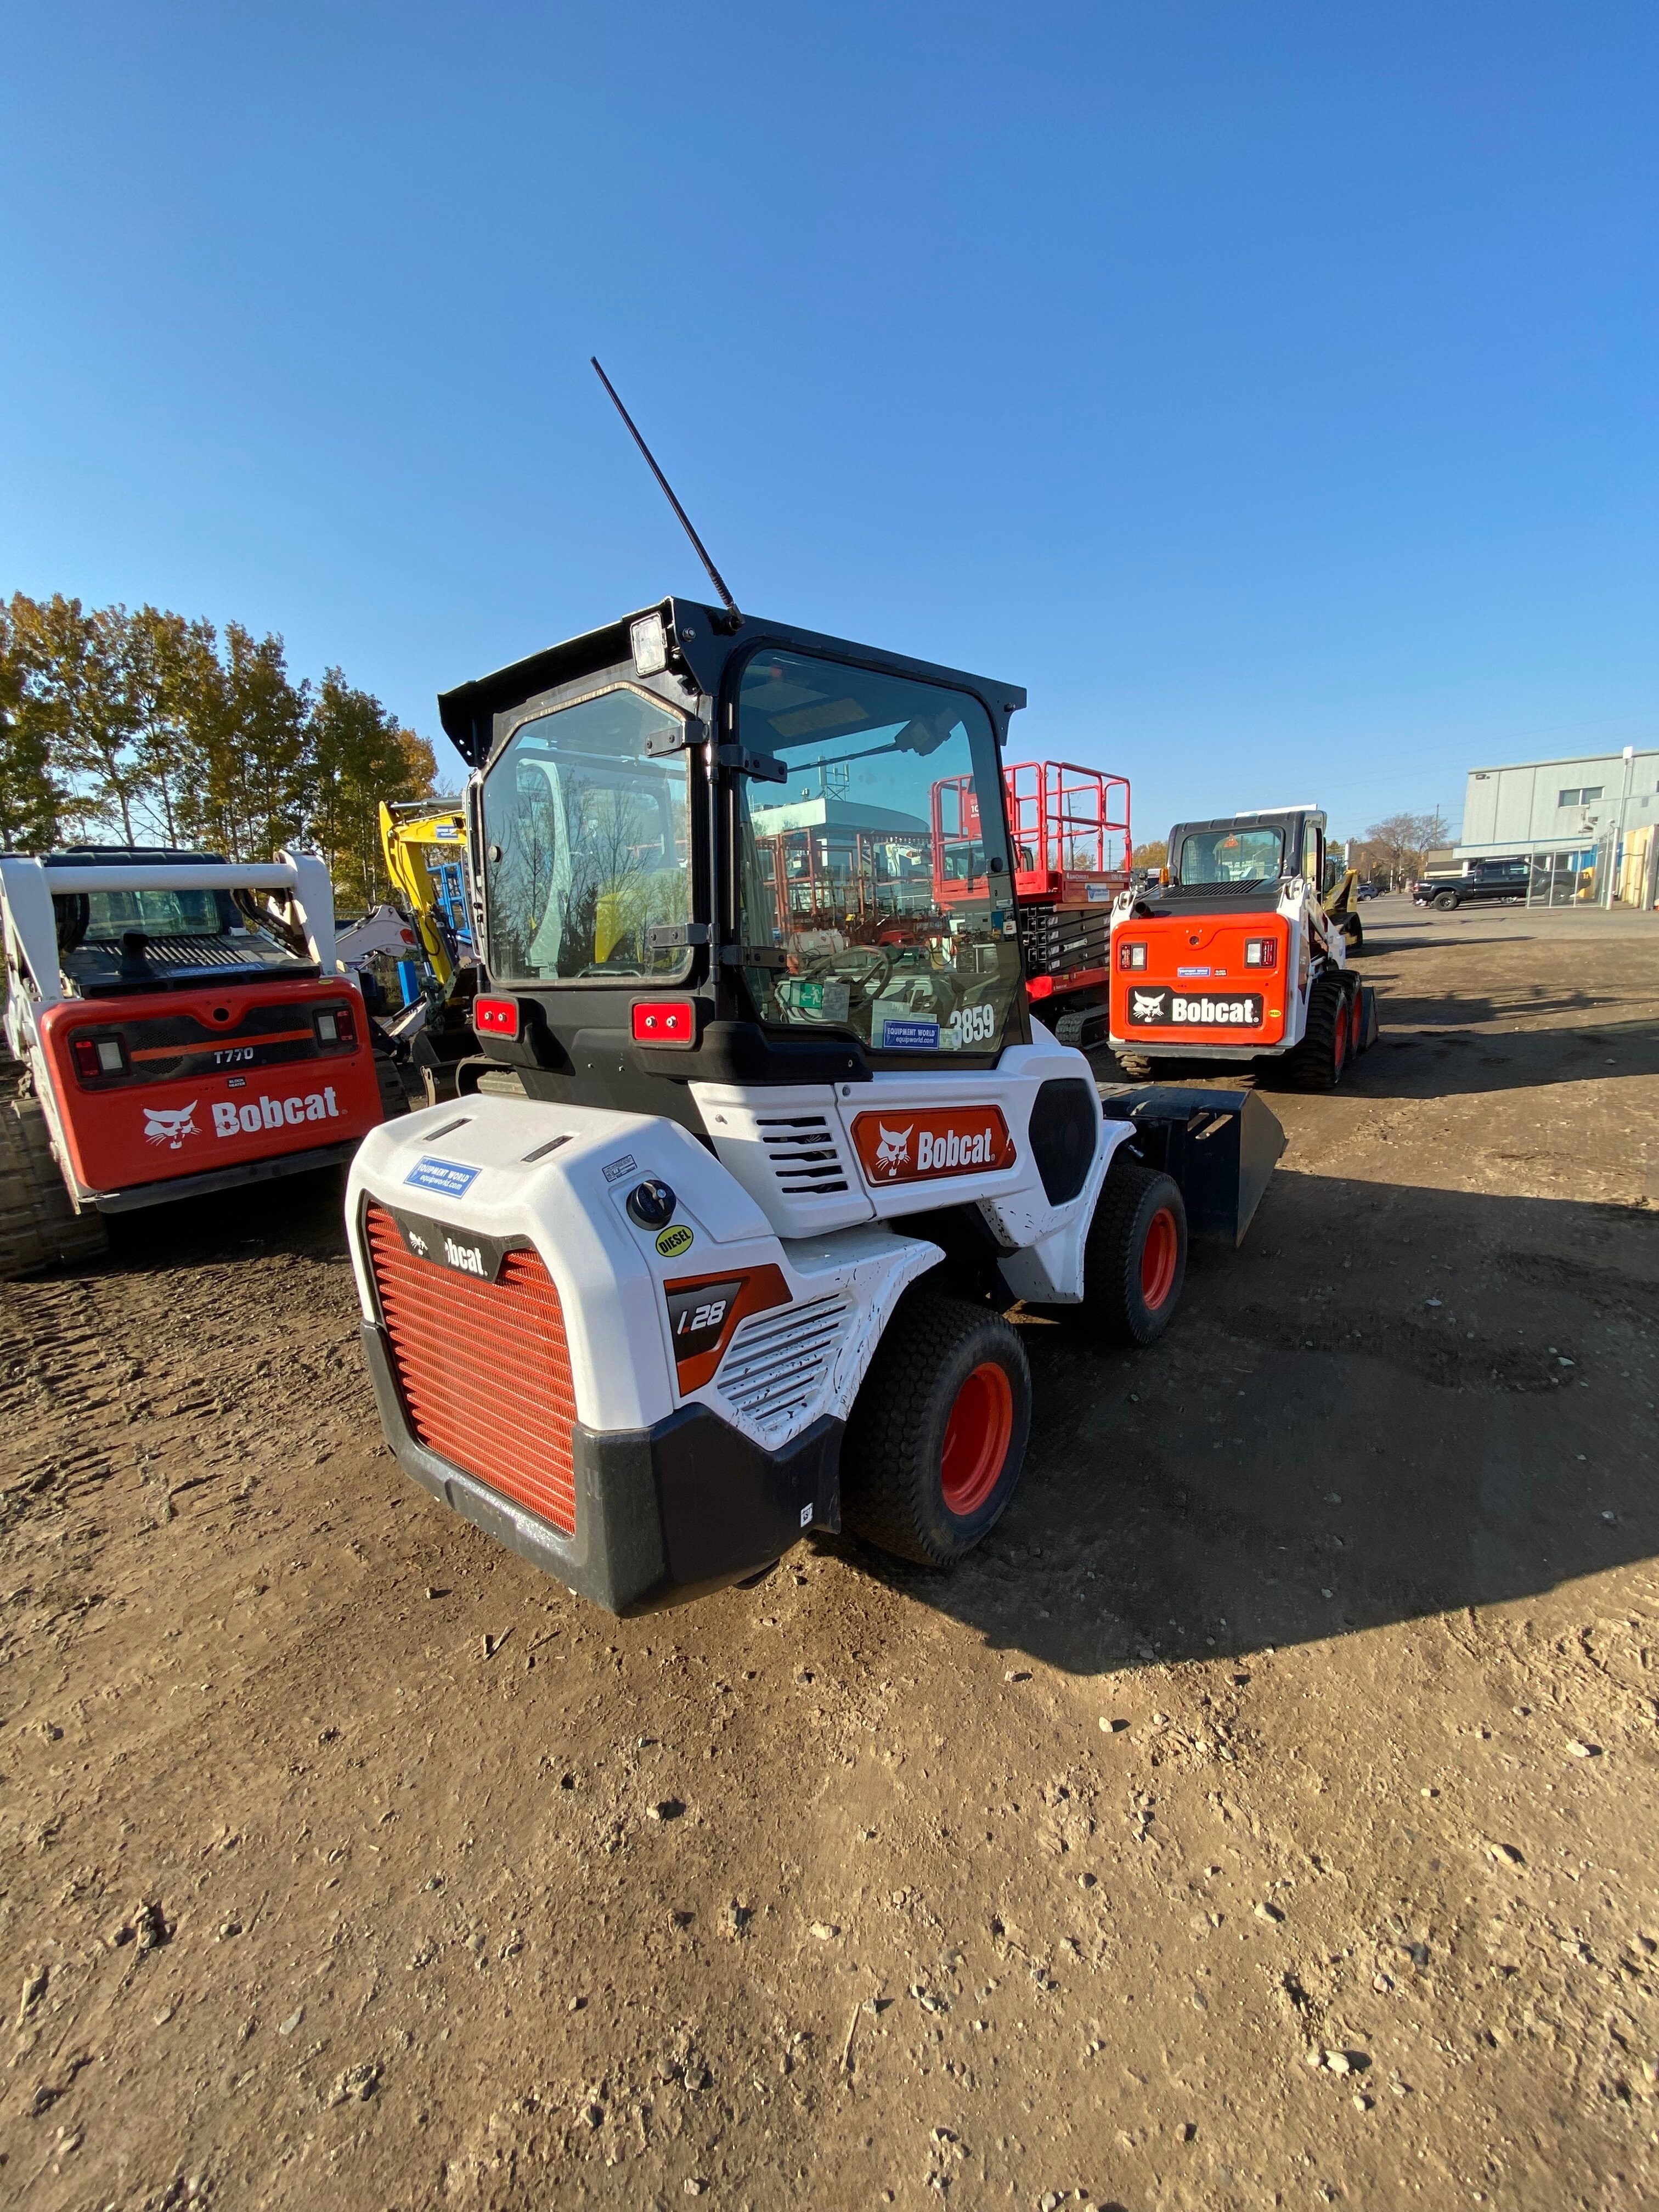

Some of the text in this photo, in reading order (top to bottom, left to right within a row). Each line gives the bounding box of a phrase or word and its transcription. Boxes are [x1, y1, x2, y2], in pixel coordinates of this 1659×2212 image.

[1172, 998, 1253, 1023] Bobcat
[887, 1027, 935, 1037] EQUIPMENT WORLD
[950, 1003, 994, 1046] 3859
[895, 1036, 934, 1045] equipworld.com
[213, 1047, 253, 1064] T770
[212, 1086, 339, 1137] Bobcat
[917, 1128, 992, 1170] Bobcat
[417, 1164, 470, 1183] EQUIPMENT WORLD
[420, 1174, 462, 1190] equipworld.com
[658, 1229, 691, 1254] DIESEL
[677, 1300, 726, 1334] L28
